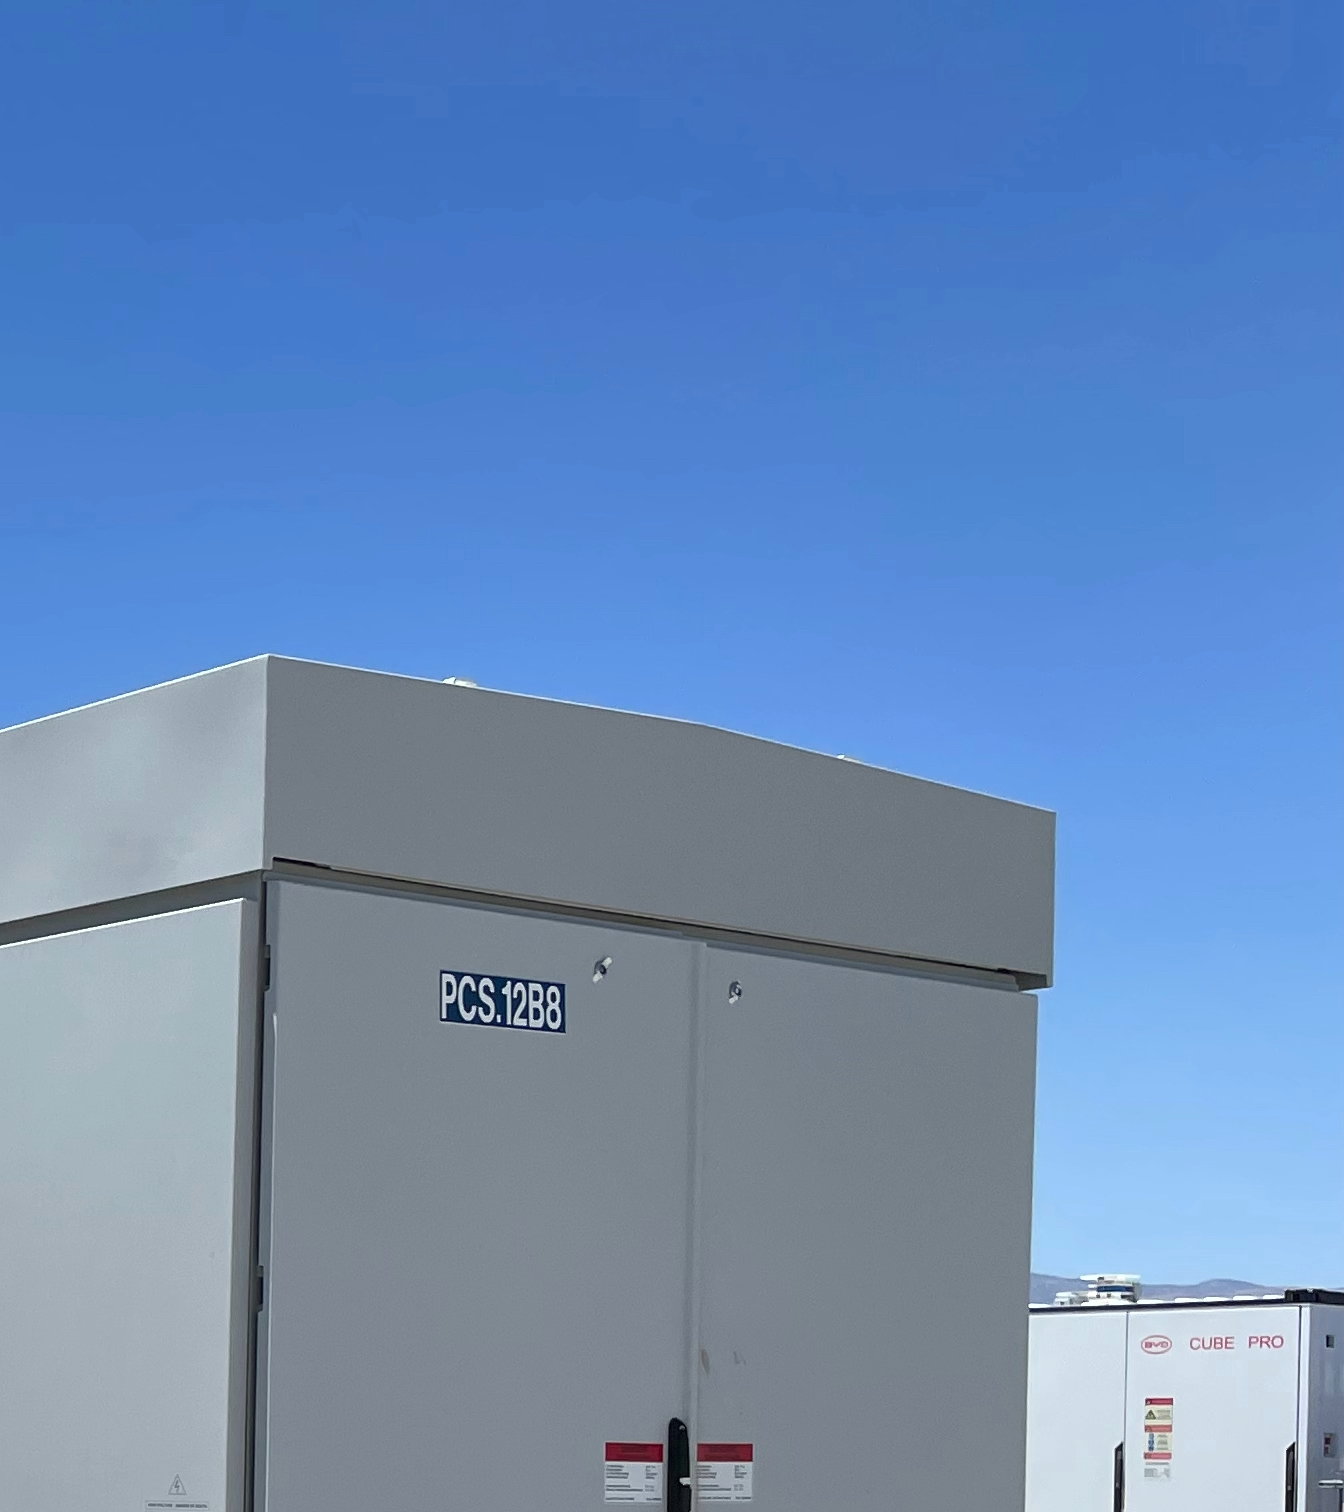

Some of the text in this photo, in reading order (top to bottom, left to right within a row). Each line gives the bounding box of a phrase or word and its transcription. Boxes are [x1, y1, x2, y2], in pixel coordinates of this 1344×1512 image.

[441, 973, 562, 1030] PCS.12B8
[1189, 1336, 1235, 1350] CUBE
[1248, 1335, 1284, 1349] PRO
